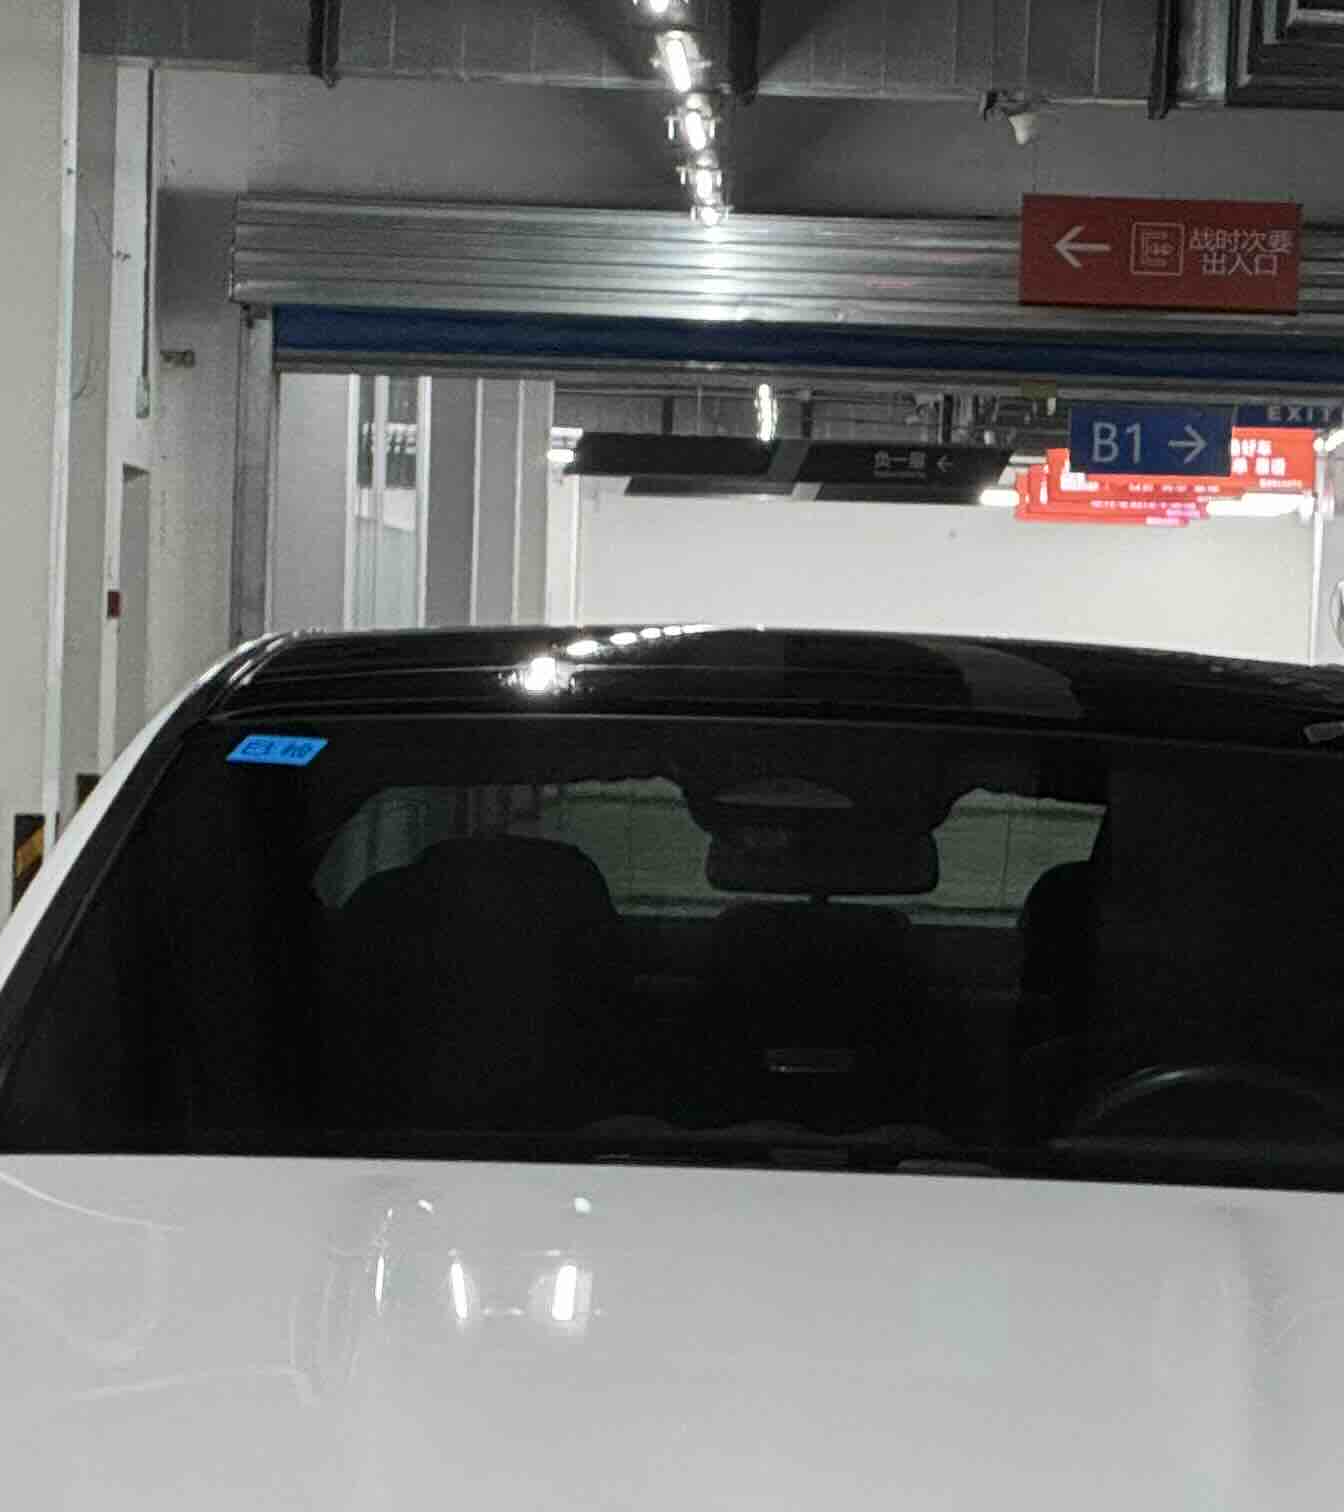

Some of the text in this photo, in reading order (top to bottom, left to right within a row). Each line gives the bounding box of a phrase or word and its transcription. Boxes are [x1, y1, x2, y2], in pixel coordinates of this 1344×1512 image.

[1188, 228, 1292, 255] 战时次要
[1202, 252, 1277, 276] 出入口
[1267, 405, 1333, 422] EXIT
[1092, 422, 1142, 463] B1
